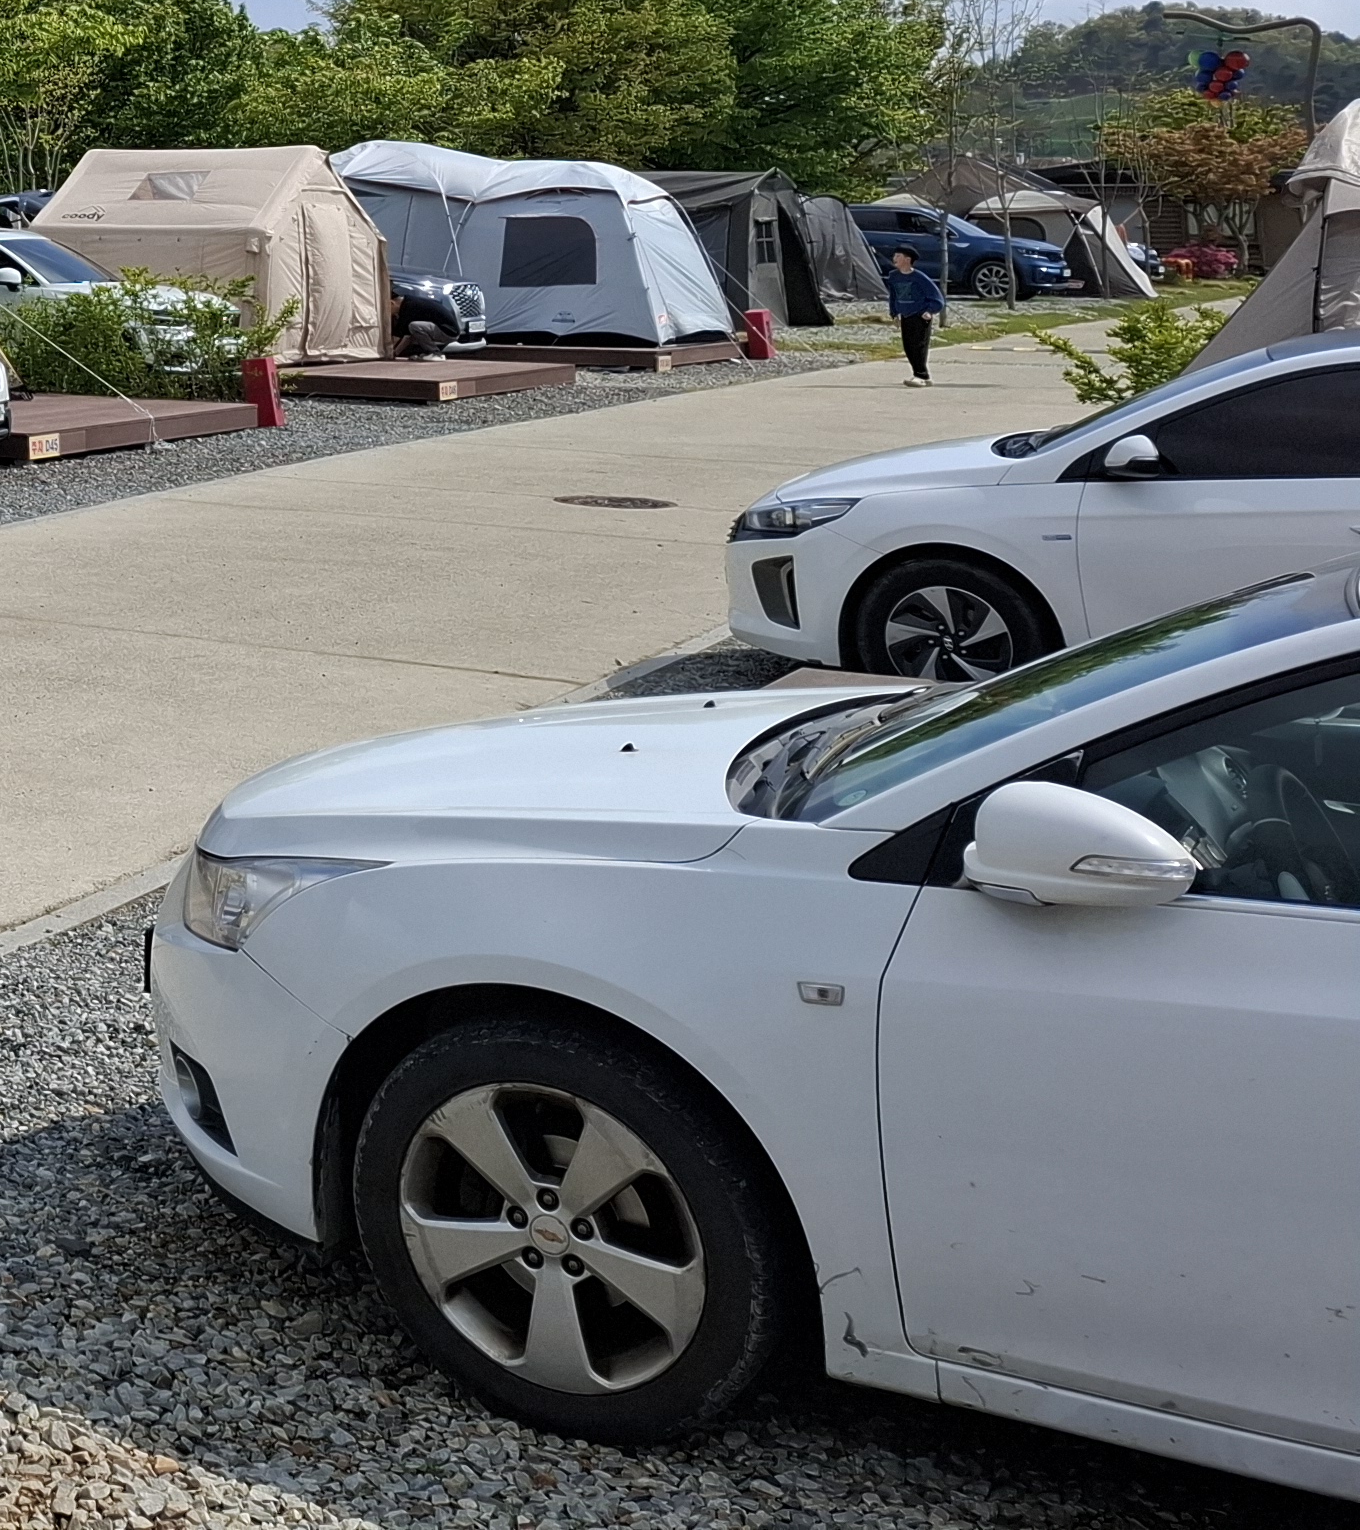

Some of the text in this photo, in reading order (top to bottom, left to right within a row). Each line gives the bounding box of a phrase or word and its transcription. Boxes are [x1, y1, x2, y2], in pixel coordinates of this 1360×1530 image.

[61, 211, 105, 221] coody
[31, 438, 59, 455] 주차 D45
